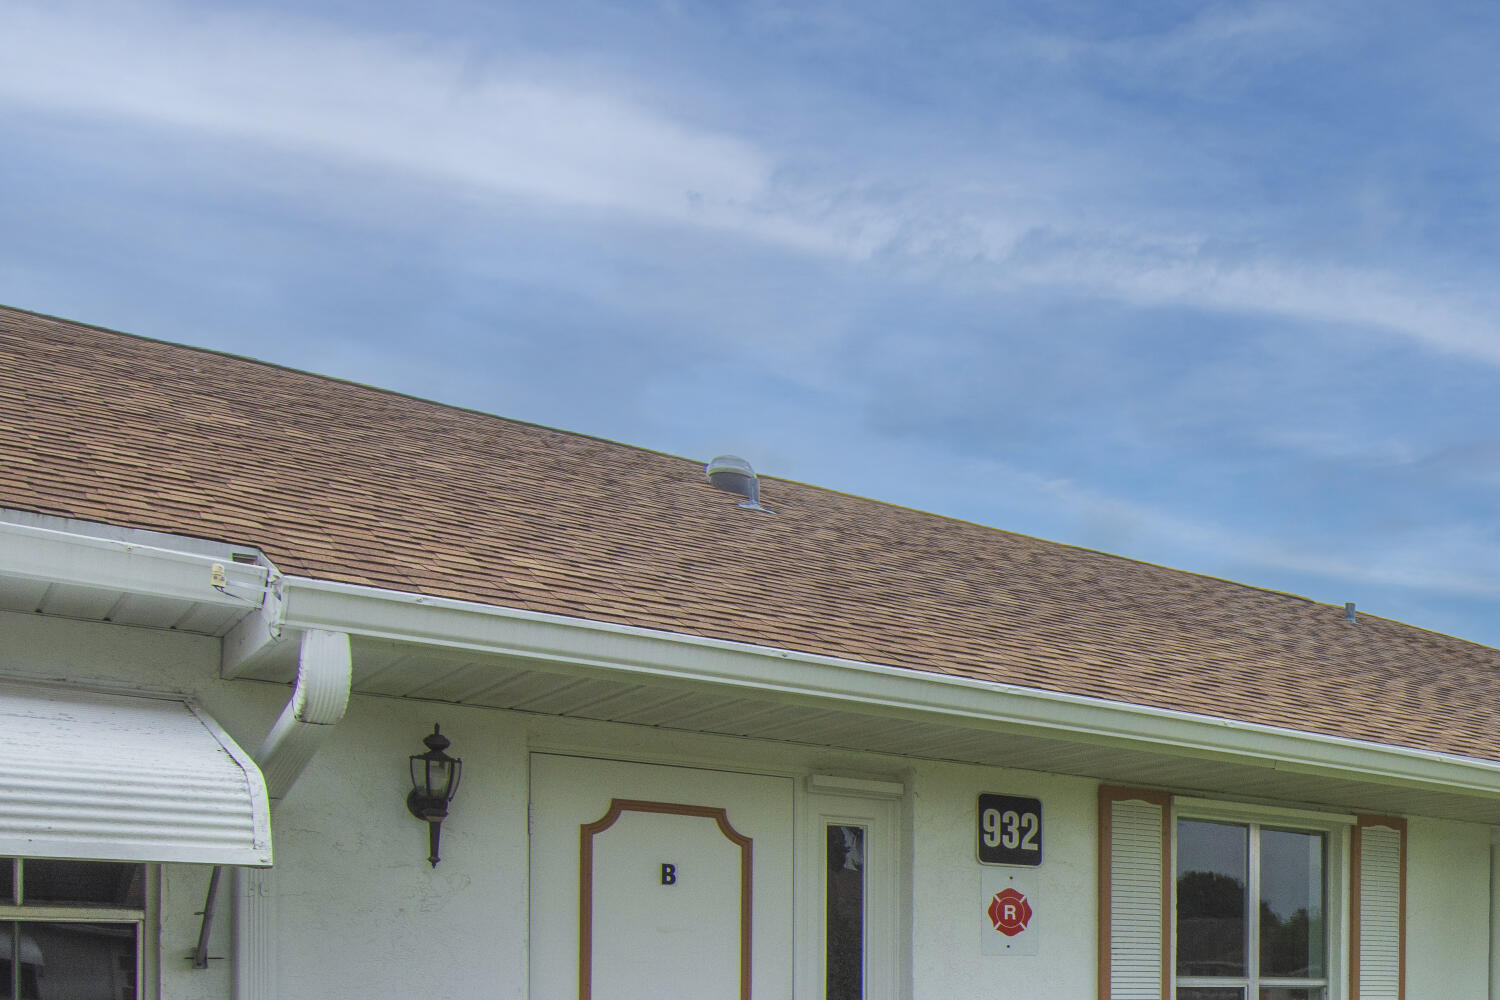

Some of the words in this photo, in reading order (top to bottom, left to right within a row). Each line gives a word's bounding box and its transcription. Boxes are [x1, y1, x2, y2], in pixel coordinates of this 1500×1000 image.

[983, 808, 1039, 851] 932
[660, 863, 677, 885] B
[1003, 904, 1017, 921] R
